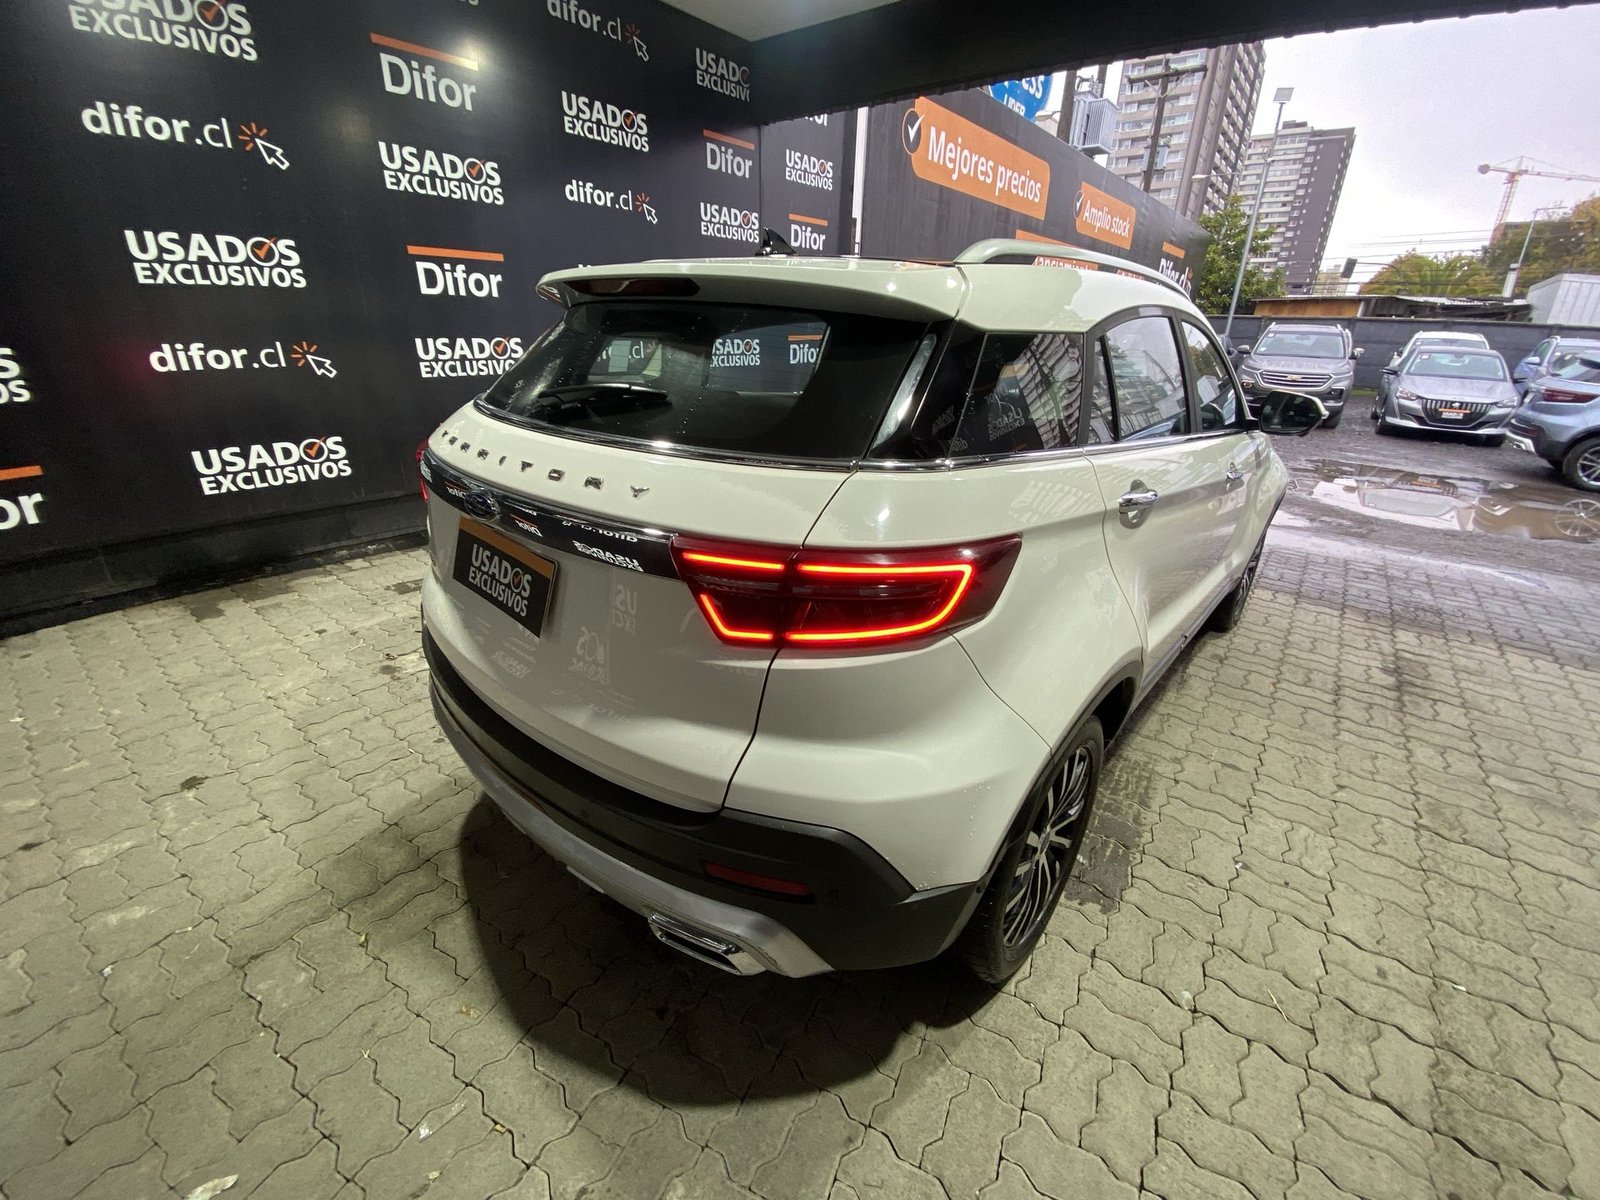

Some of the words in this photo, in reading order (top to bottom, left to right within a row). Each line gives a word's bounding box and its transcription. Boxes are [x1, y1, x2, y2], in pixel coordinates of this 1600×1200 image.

[71, 5, 258, 61] EXCLUSIVOS
[379, 52, 477, 111] Difor
[81, 101, 233, 149] difor.cl
[561, 90, 648, 136] USADOS
[564, 115, 649, 152] EXCLUSIVOS
[378, 141, 501, 186] USADOS
[706, 142, 752, 179] Difor
[785, 149, 833, 178] USADOS
[785, 167, 833, 191] EXCLUSIVOS
[927, 126, 994, 184] Mejores
[995, 164, 1042, 204] precios
[383, 169, 504, 206] EXCLUSIVOS
[564, 179, 632, 211] difor.cl
[700, 202, 759, 229] USADOS
[701, 221, 760, 244] EXCLUSIVOS
[1083, 200, 1110, 231] Amplio
[1111, 213, 1131, 239] stock
[124, 229, 301, 268] USADOS
[790, 223, 826, 251] Difor
[132, 262, 307, 289] EXCLUSIVOS
[415, 261, 503, 298] Difor
[149, 341, 286, 373] difor.cl
[414, 337, 524, 360] USADOS
[709, 354, 760, 367] XCLUSIVOS
[191, 436, 347, 476] USADOS
[199, 459, 352, 495] EXCLUSIVOS
[471, 543, 533, 599] USADOS
[467, 568, 529, 618] EXCLUSIVOS
